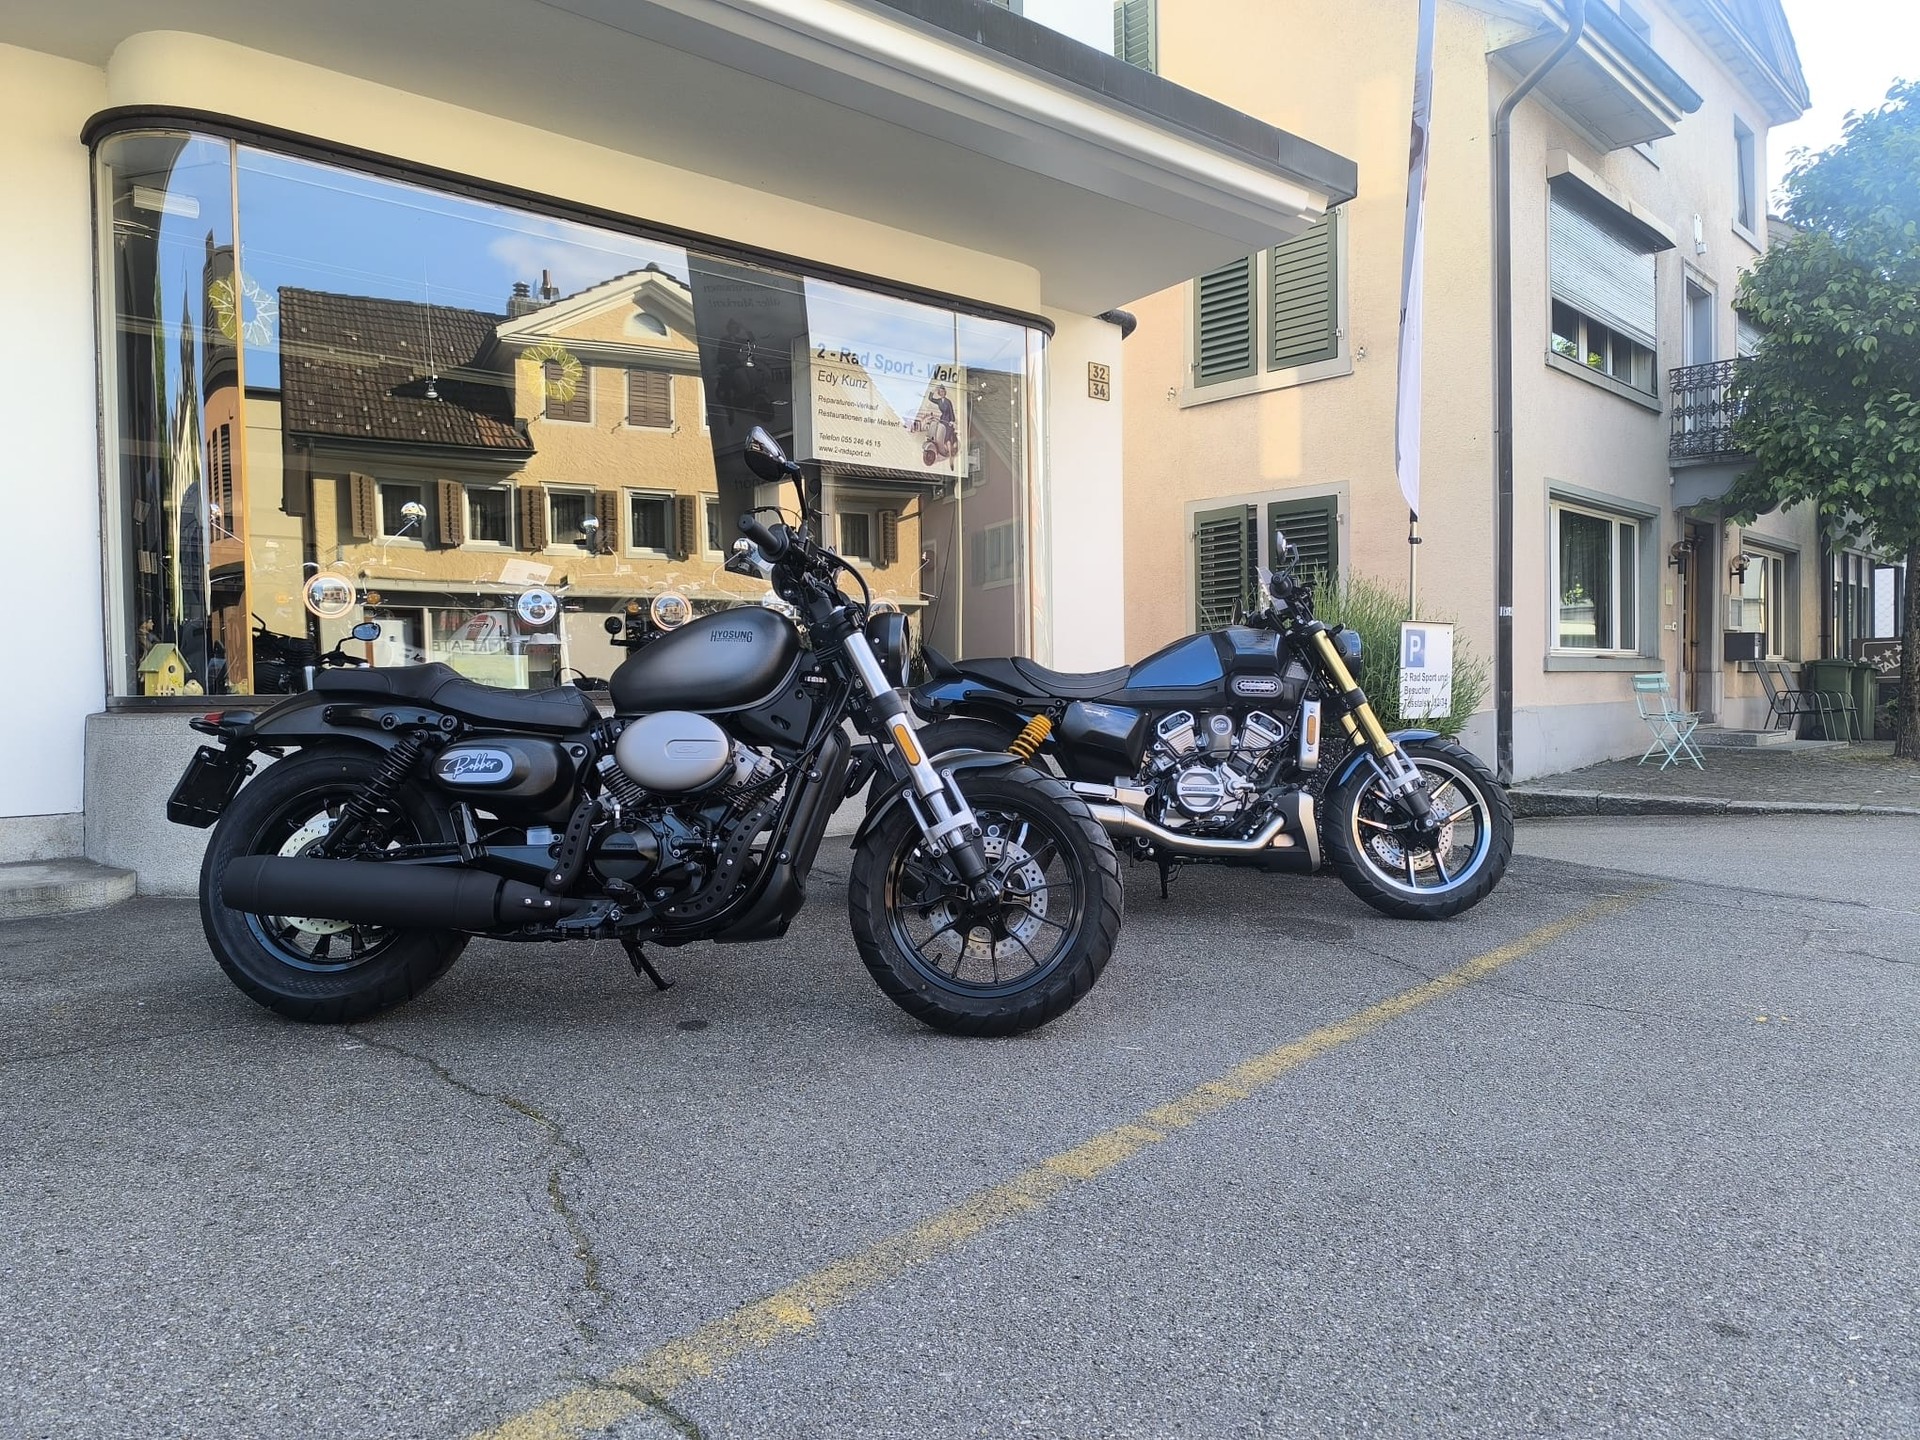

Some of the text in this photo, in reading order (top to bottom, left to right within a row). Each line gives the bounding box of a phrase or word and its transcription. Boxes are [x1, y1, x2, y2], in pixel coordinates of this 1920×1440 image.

[816, 343, 826, 359] 2
[839, 346, 869, 366] Rad
[874, 353, 914, 375] Sport
[817, 370, 868, 390] Edy Kunz
[1093, 365, 1106, 380] 32
[1093, 383, 1106, 398] 34
[818, 409, 900, 428] Restaurationen aller Marken!
[819, 432, 840, 443] Telefon
[840, 435, 853, 444] 055
[865, 438, 874, 447] 45
[818, 446, 872, 458] www.2-radsport.ch
[710, 630, 753, 643] HYOSUNG
[1409, 635, 1421, 663] P
[1409, 672, 1421, 682] Rad
[1421, 672, 1437, 683] Sport
[1404, 685, 1431, 695] Besucher
[443, 752, 498, 779] Bobber
